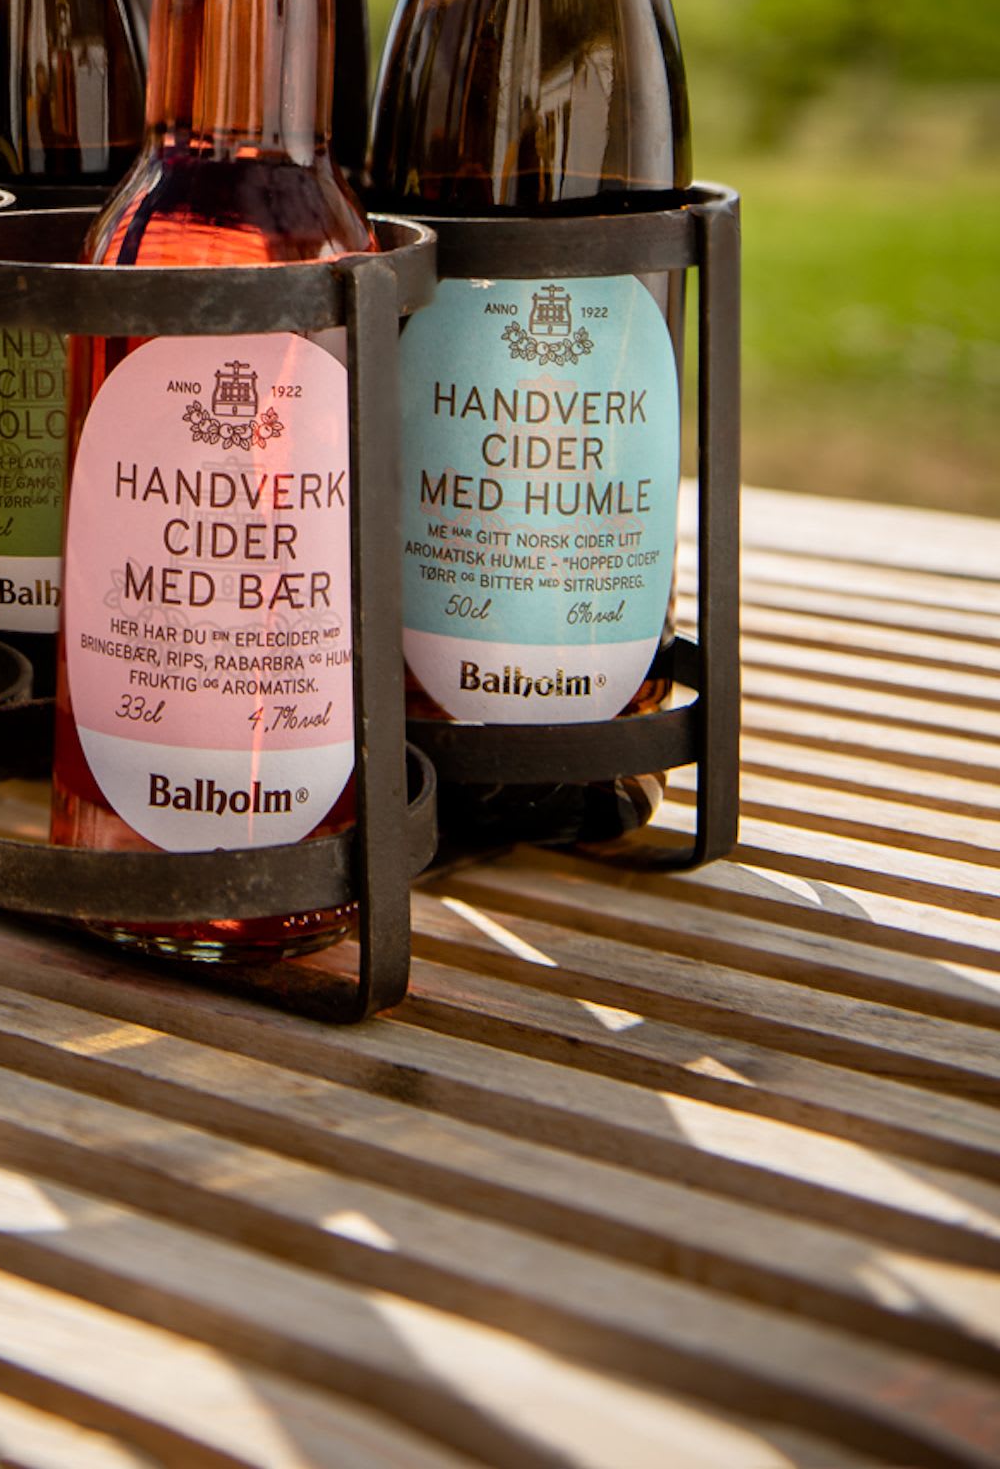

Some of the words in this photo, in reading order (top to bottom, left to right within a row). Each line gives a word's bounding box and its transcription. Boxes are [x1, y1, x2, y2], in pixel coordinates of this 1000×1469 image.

[484, 302, 518, 315] ANNO
[581, 307, 608, 318] 1922
[167, 380, 201, 394] ANNO
[271, 386, 302, 398] 1922
[434, 381, 647, 424] HANDVERK
[482, 433, 604, 470] CIDER
[16, 476, 57, 490] GANG
[116, 461, 346, 510] HANDVERK
[420, 469, 503, 511] MED
[525, 479, 651, 516] HUMLE
[163, 518, 297, 560] CIDER
[428, 523, 448, 539] ME
[452, 526, 472, 538] HAR
[476, 530, 511, 546] GITT
[516, 533, 570, 549] NORSK
[574, 533, 615, 548] CIDER
[618, 531, 642, 547] LITT
[404, 540, 486, 566] AROMATISK
[491, 553, 546, 570] HUMLE
[563, 555, 624, 570] "HOPPED
[124, 562, 215, 607] MED
[238, 571, 331, 610] BÆR
[419, 564, 456, 583] TØRR
[461, 571, 475, 582] OG
[480, 573, 533, 591] BITTER
[539, 578, 560, 588] MED
[563, 574, 645, 593] SITRUSPREG.
[445, 594, 492, 620] 50cl
[566, 600, 625, 625] 6%vol
[111, 618, 138, 637] HER
[144, 624, 177, 642] HAR
[183, 629, 206, 645] DU
[212, 631, 230, 642] EIN
[235, 630, 319, 648] EPLECIDER
[323, 627, 340, 638] MED
[81, 633, 161, 666] BRINGEBÆR,
[167, 651, 208, 672] RIPS,
[214, 654, 305, 672] RABARBRA
[309, 653, 322, 664] OG
[326, 649, 351, 667] HUM
[130, 670, 197, 692] FRUKTIG
[203, 678, 219, 689] OG
[221, 678, 319, 695] AROMATISK.
[115, 694, 166, 724] 33cl
[248, 701, 333, 733] 4,7%vol
